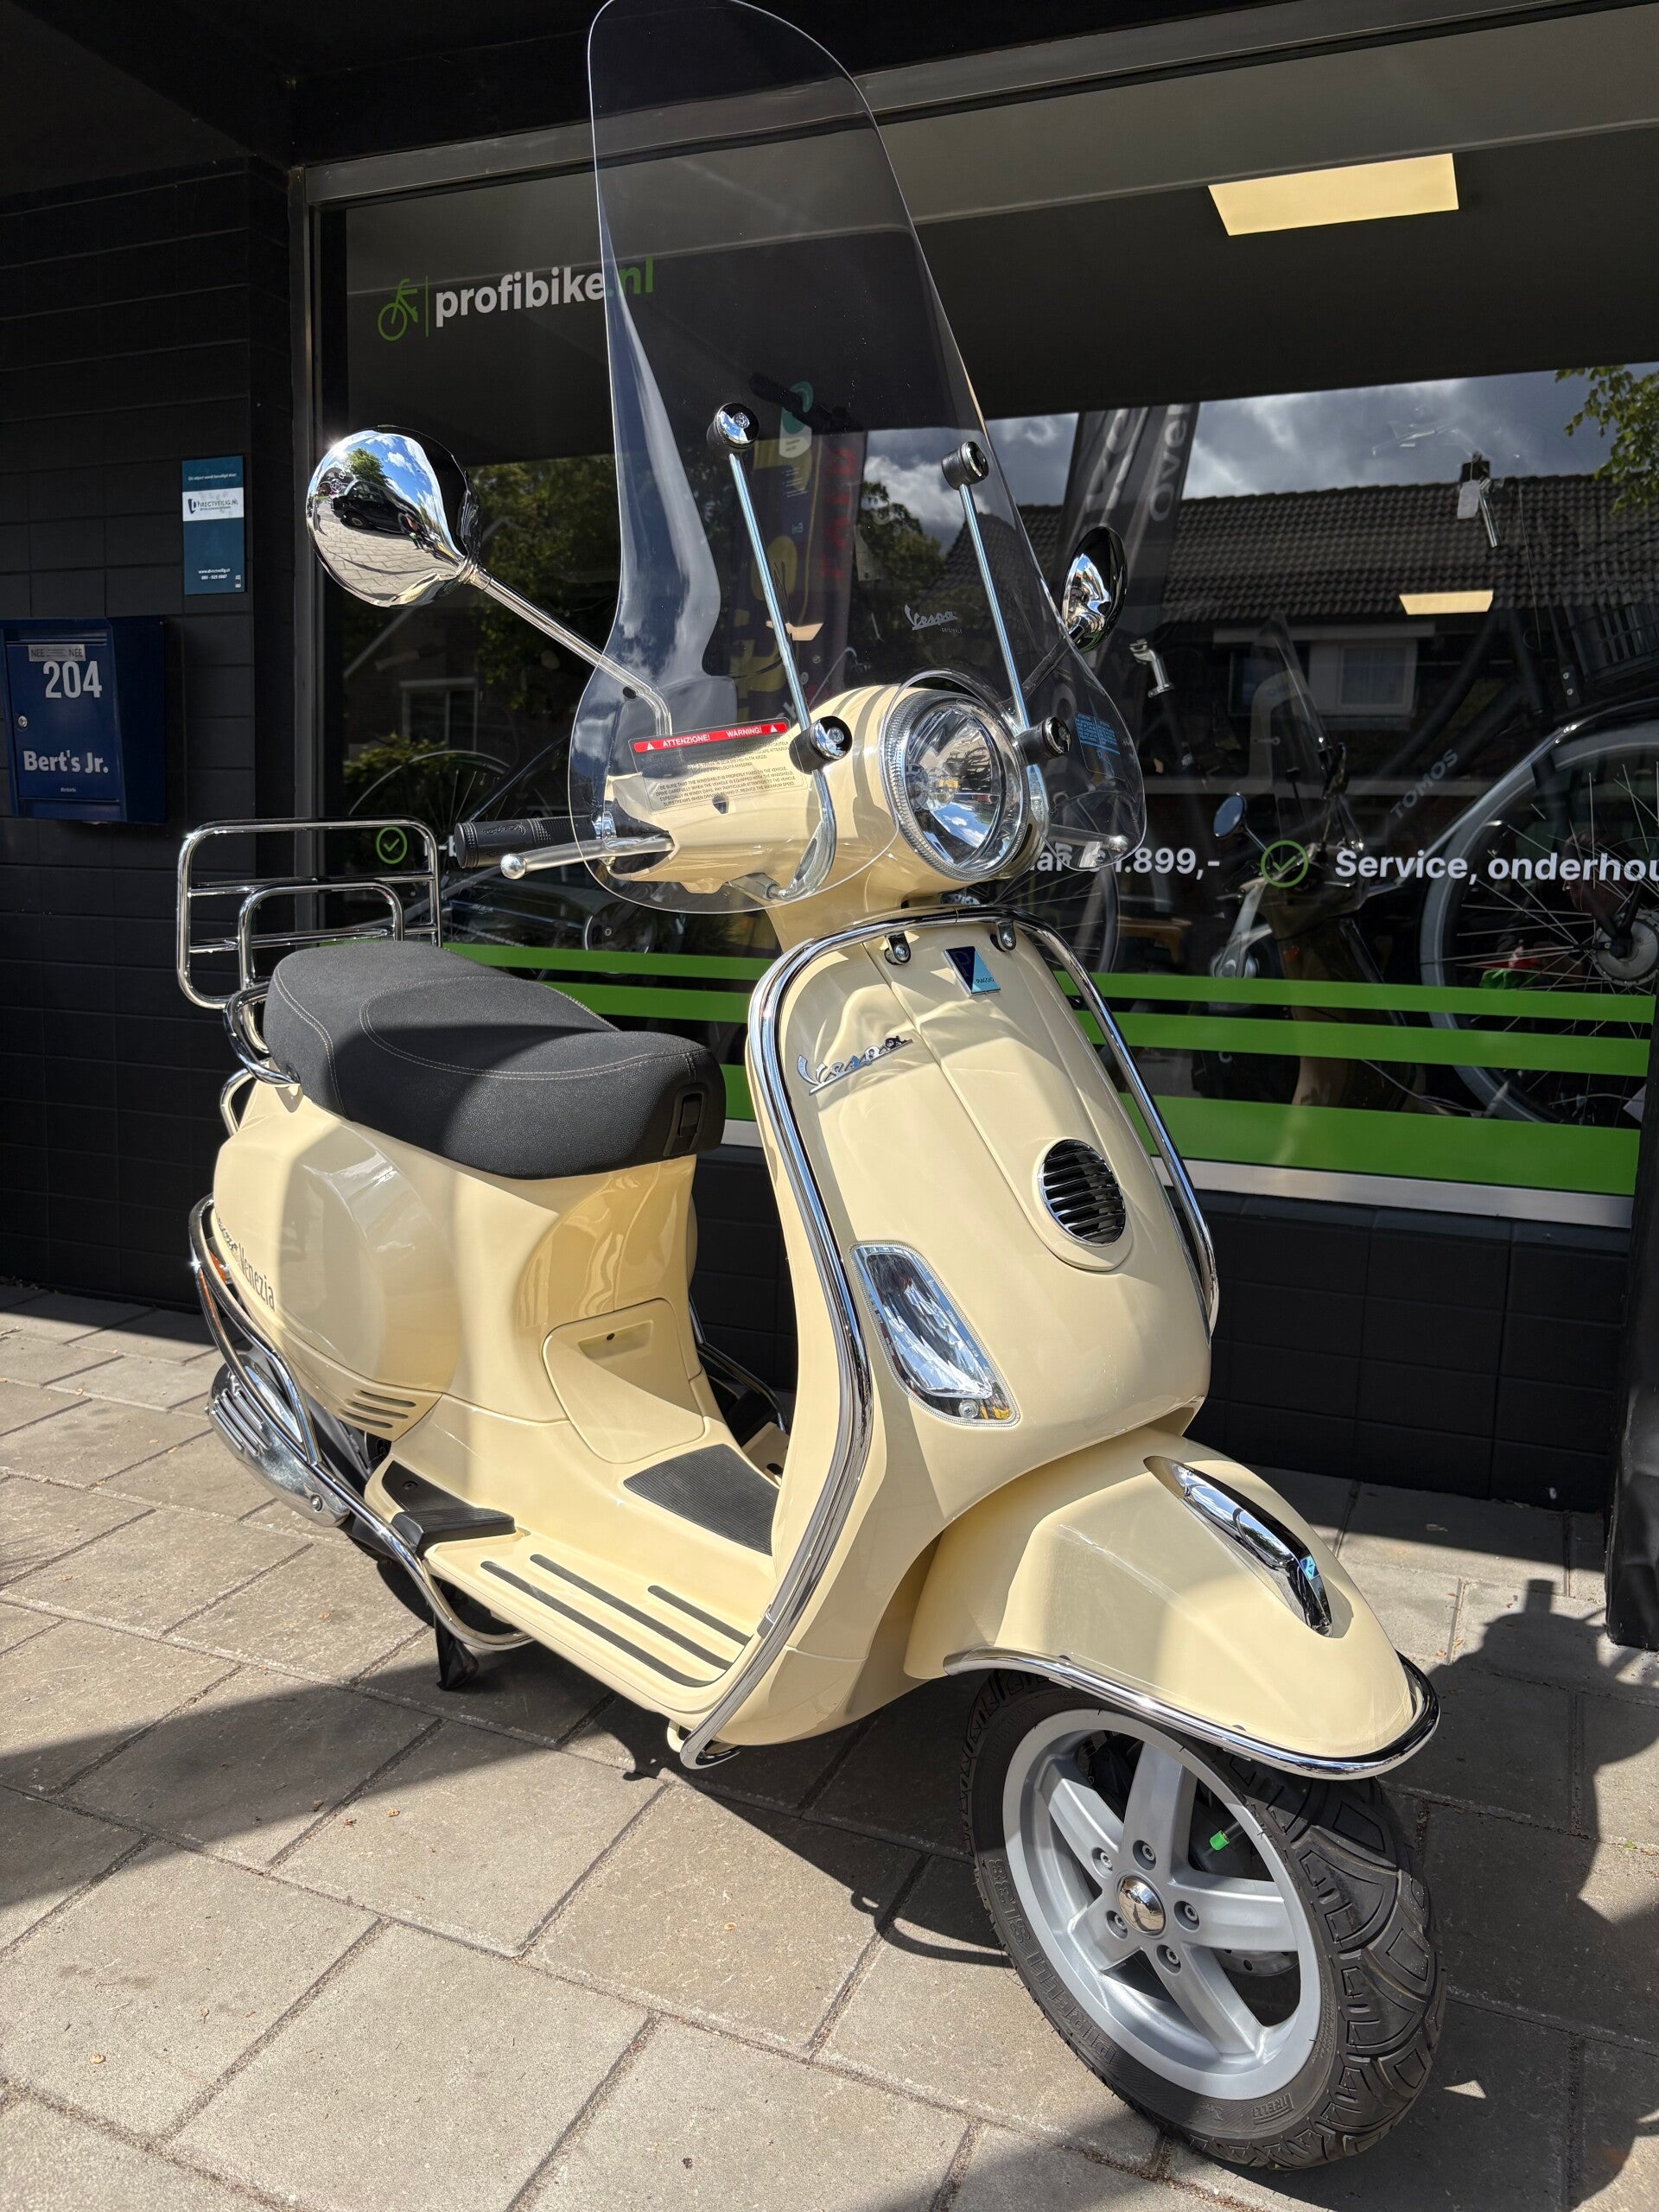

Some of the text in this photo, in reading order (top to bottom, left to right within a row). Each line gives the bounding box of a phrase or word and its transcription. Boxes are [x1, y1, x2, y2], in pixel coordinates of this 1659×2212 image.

[435, 256, 654, 328] profibike.nl
[905, 603, 959, 631] Vespa
[30, 648, 45, 658] NEE
[68, 648, 84, 658] NEE
[43, 660, 103, 699] 204
[662, 727, 762, 747] ATTENZIONE! WARNING!
[23, 750, 109, 773] Bert's Jr.
[1389, 747, 1458, 819] TOMOS
[1335, 849, 1477, 885] Service,
[796, 1035, 913, 1096] Vespa
[238, 1242, 276, 1313] Venezia
[1026, 1950, 1118, 2066] PIRELLI
